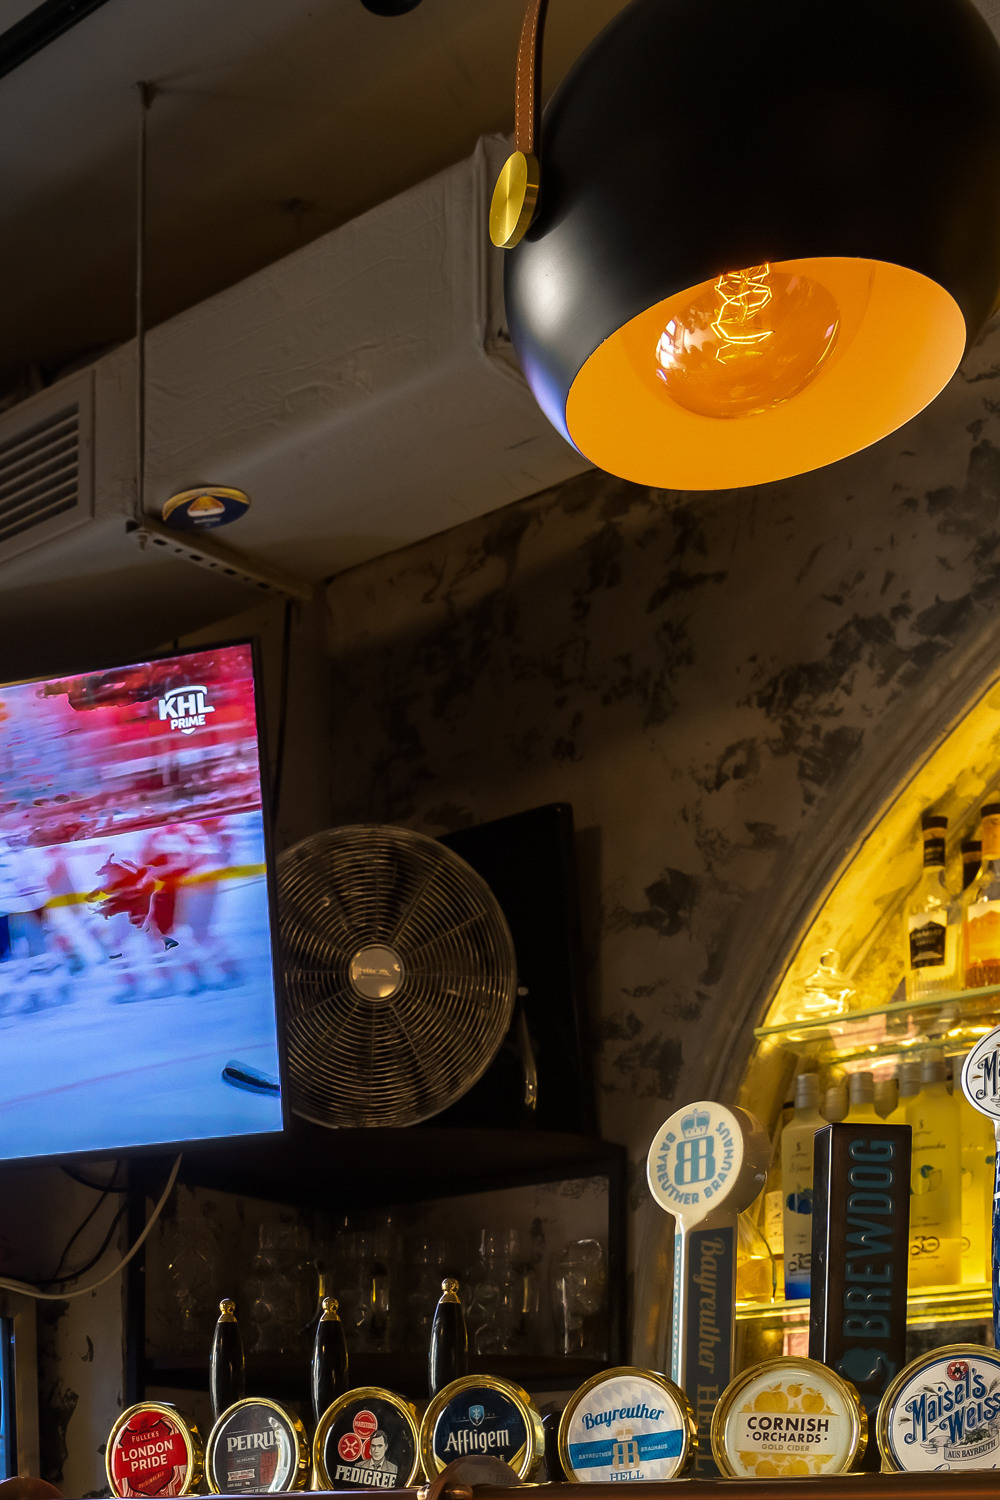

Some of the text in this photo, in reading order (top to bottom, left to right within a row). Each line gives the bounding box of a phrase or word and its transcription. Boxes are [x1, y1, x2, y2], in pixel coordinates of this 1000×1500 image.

[158, 693, 215, 720] KHL
[170, 714, 206, 730] PRIME
[656, 1122, 734, 1204] BAYREUTHER BRAUHAUS
[843, 1139, 895, 1338] BREWDOG
[693, 1237, 726, 1374] Bayreuther
[582, 1404, 664, 1430] Bayreuther
[904, 1367, 987, 1445] Maisel's
[747, 1417, 829, 1432] CORNISH
[132, 1431, 160, 1442] FULLER'S
[227, 1430, 281, 1452] PETRUS
[444, 1429, 510, 1455] Affligem
[752, 1431, 821, 1443] ORCHARDS
[122, 1439, 173, 1461] LONDON
[579, 1444, 668, 1460] BAYREUTHER BRAUHAUS
[948, 1440, 996, 1459] AUS BAYREUTH
[131, 1454, 168, 1472] PRIDE
[335, 1465, 397, 1488] PEDIGREE
[609, 1470, 644, 1482] HELL
